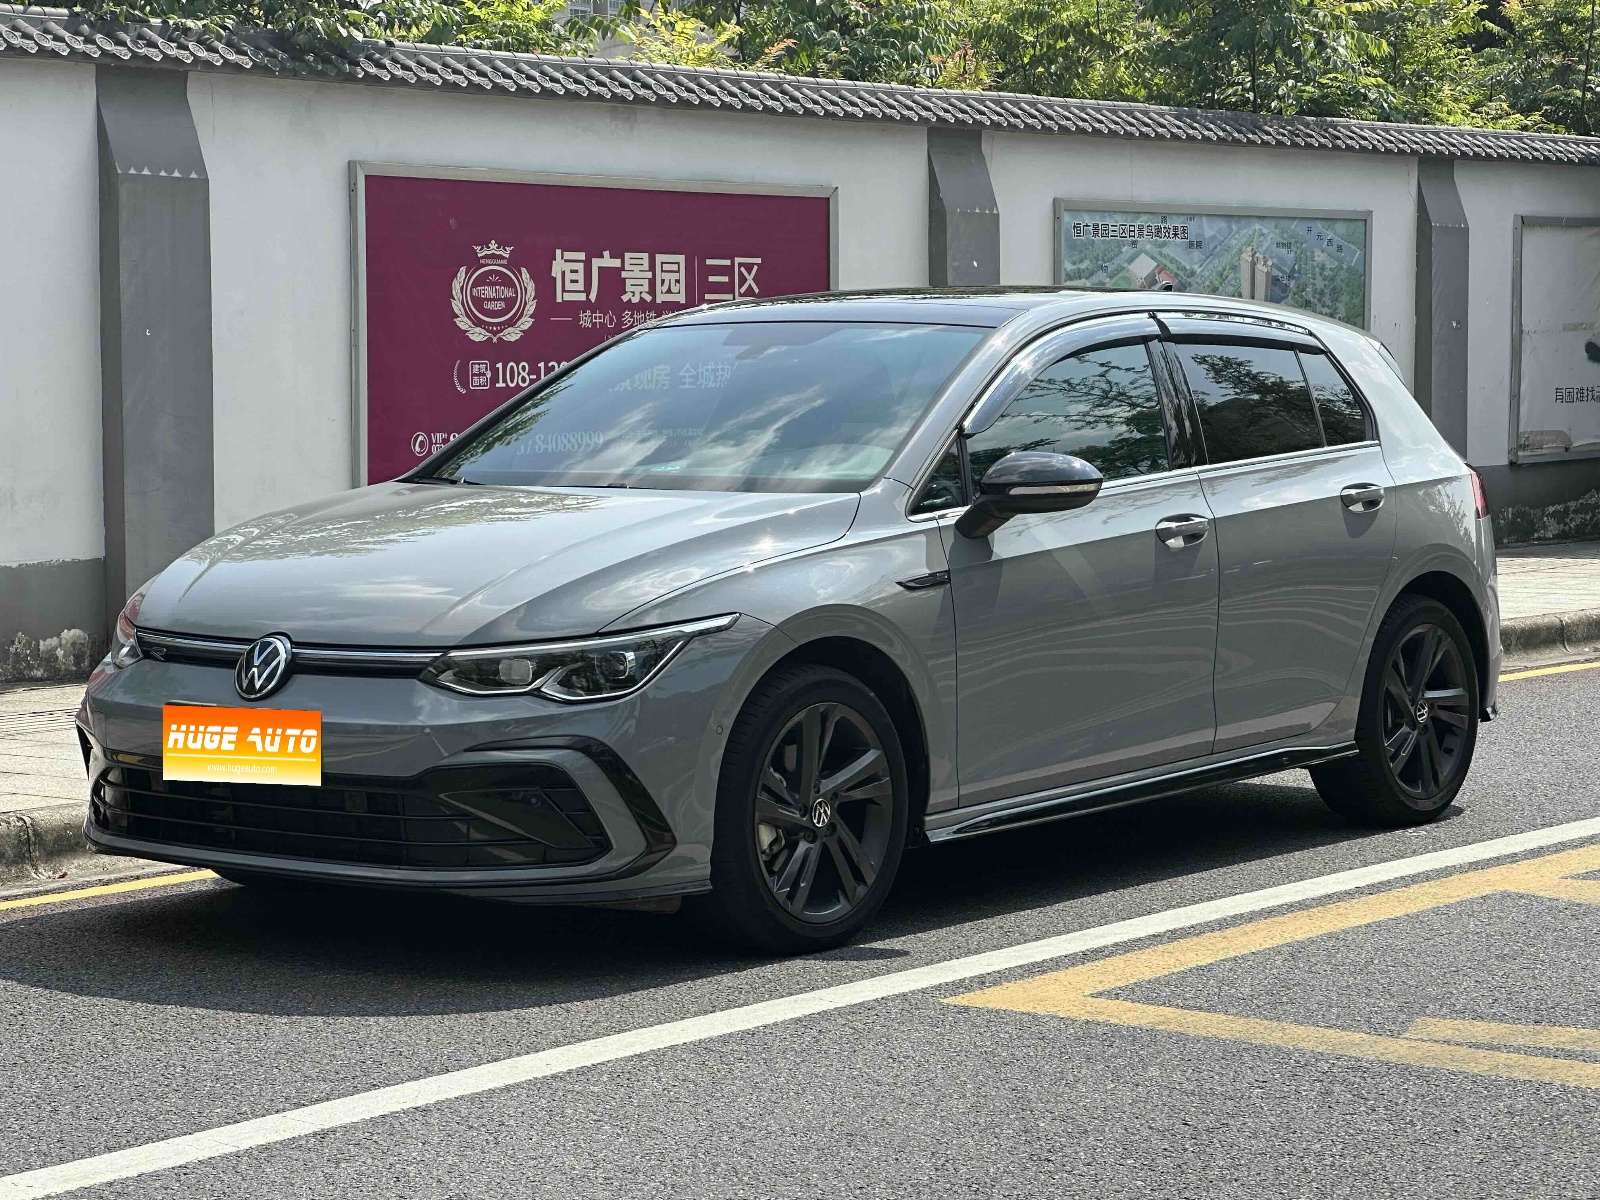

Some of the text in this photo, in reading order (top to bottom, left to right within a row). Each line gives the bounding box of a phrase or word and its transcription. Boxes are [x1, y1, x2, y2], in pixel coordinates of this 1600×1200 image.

[1072, 221, 1189, 241] 恒广景园三区日景鸟瞰效果图
[551, 248, 762, 304] 恒广景园 三区
[471, 286, 516, 299] INTERNATIONAL
[483, 301, 506, 310] GARDEN
[579, 310, 617, 329] 城中心
[472, 363, 487, 374] 建筑
[472, 376, 487, 387] 面积
